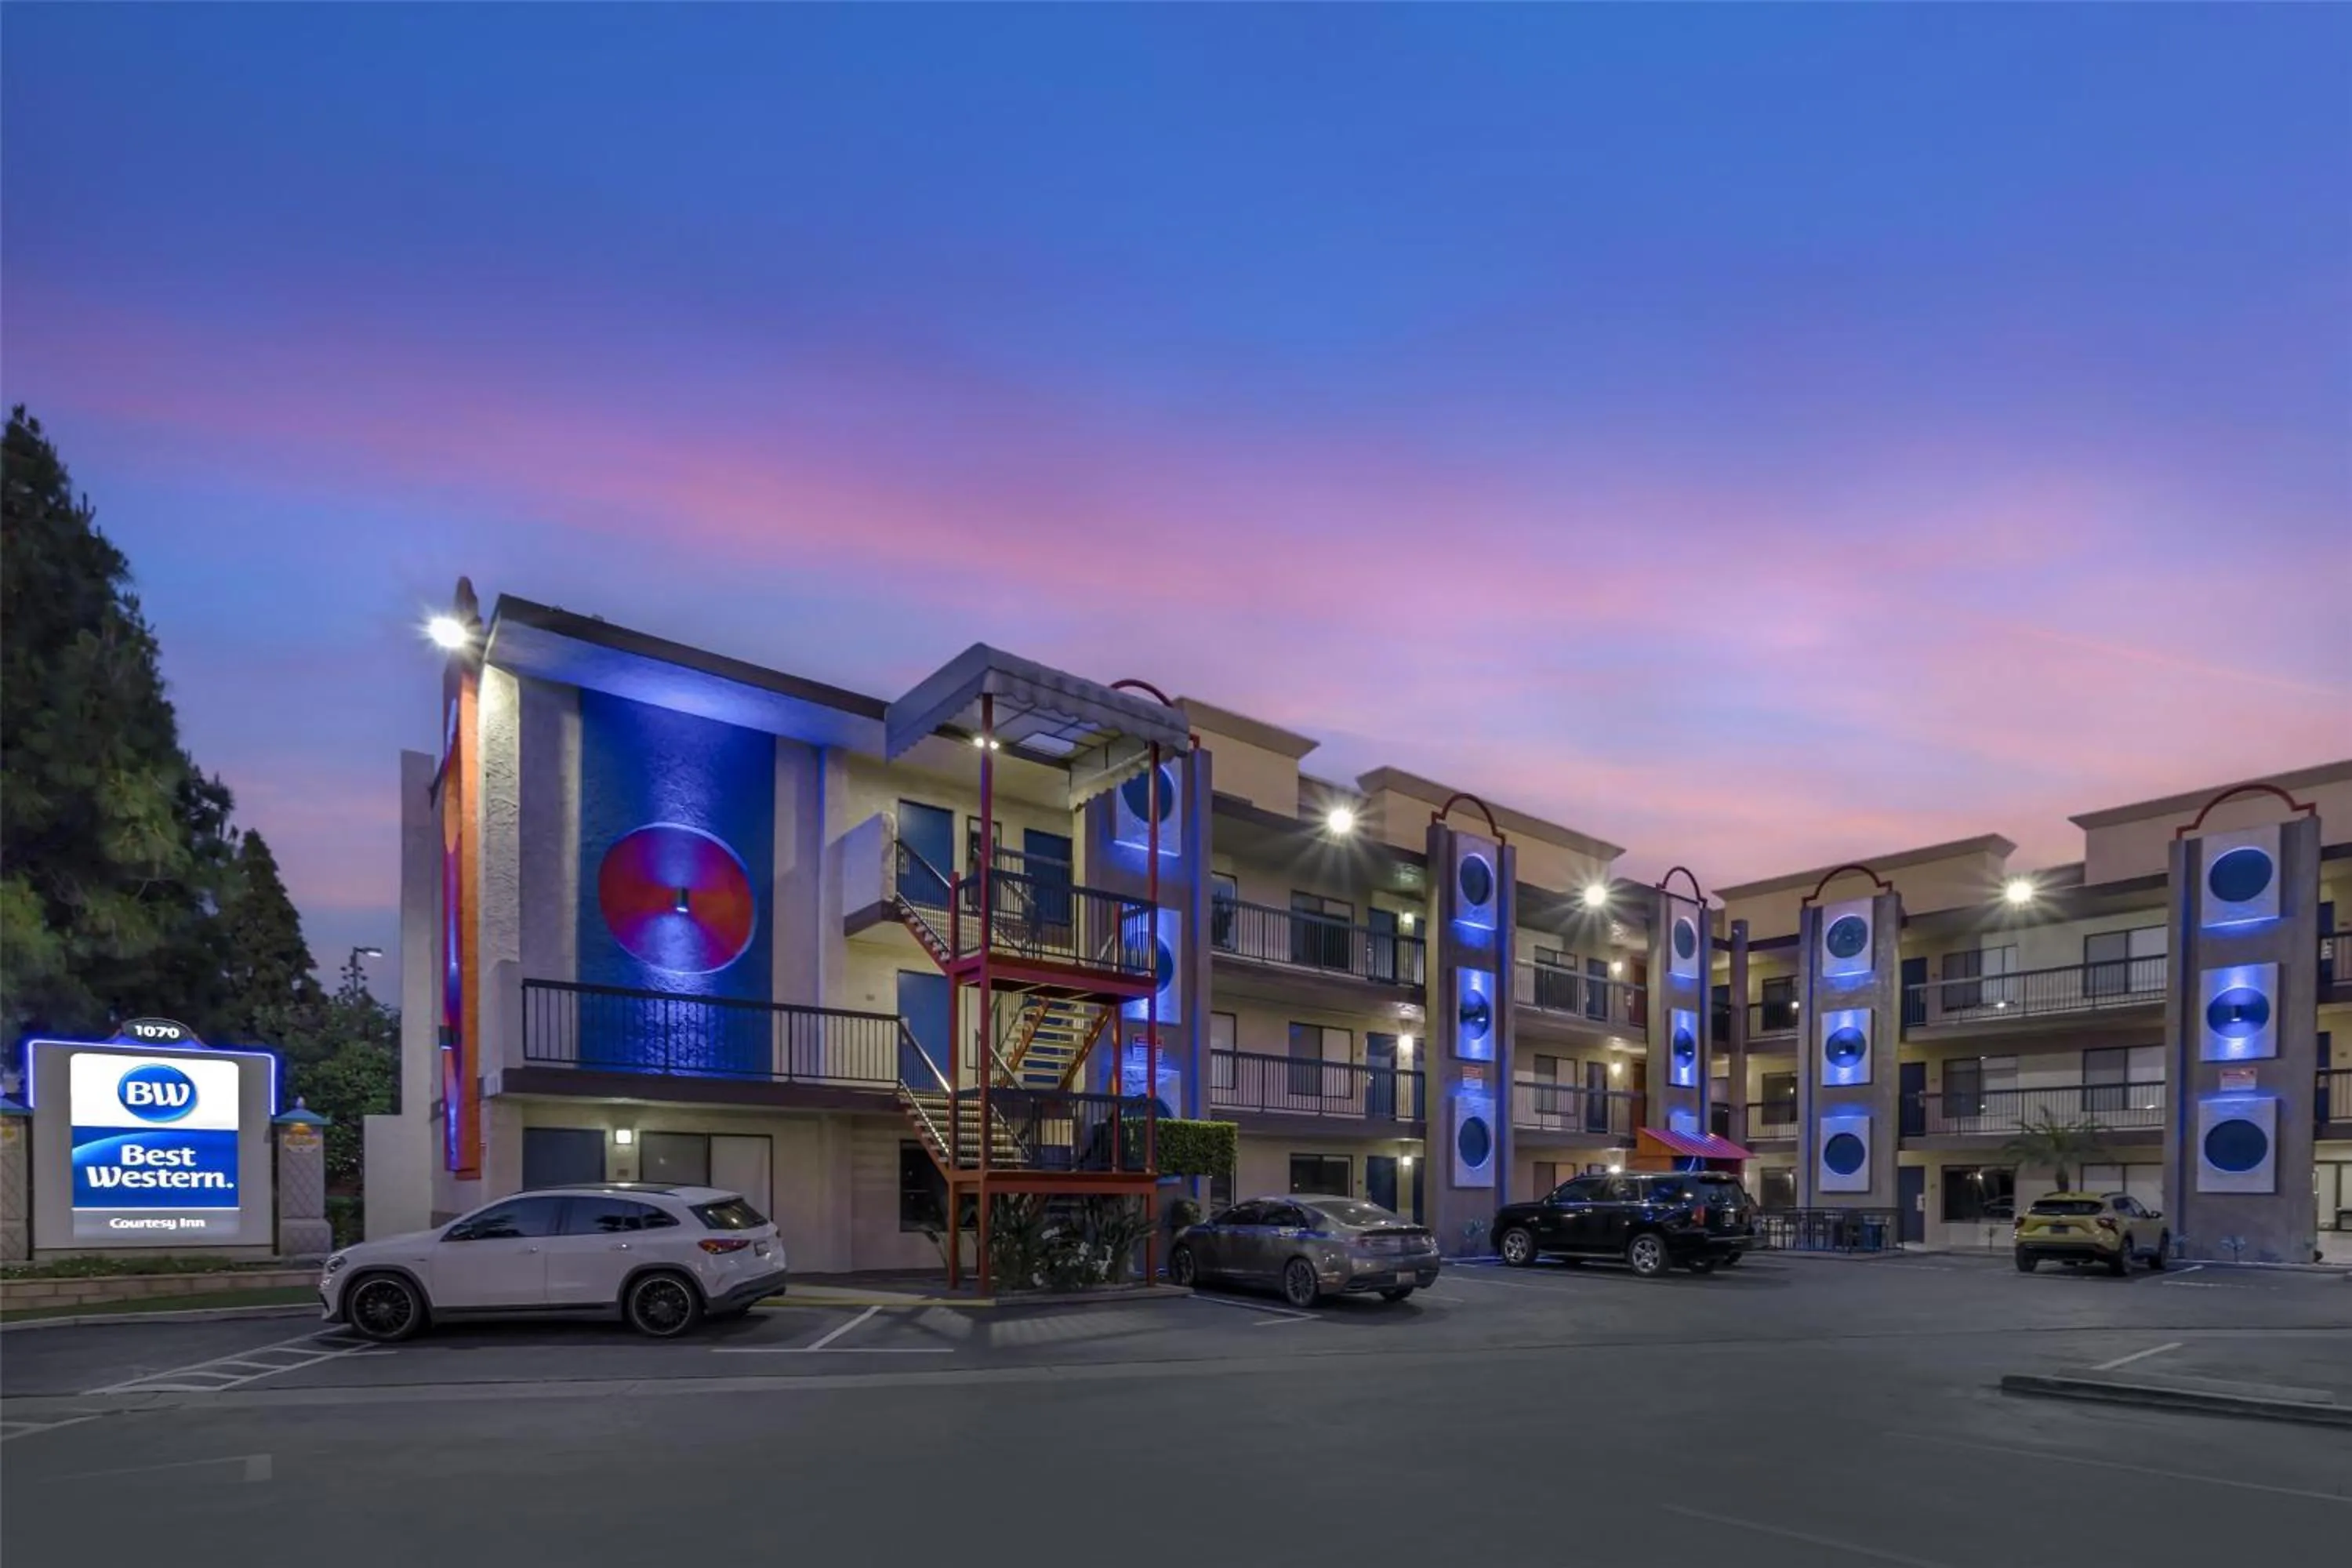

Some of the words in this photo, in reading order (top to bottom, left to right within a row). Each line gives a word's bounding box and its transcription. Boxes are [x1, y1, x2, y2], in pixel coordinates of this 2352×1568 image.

[134, 1025, 180, 1039] 1070
[126, 1081, 190, 1106] BW
[121, 1144, 196, 1166] Best
[109, 1218, 176, 1230] Courtesy
[180, 1218, 205, 1228] Inn
